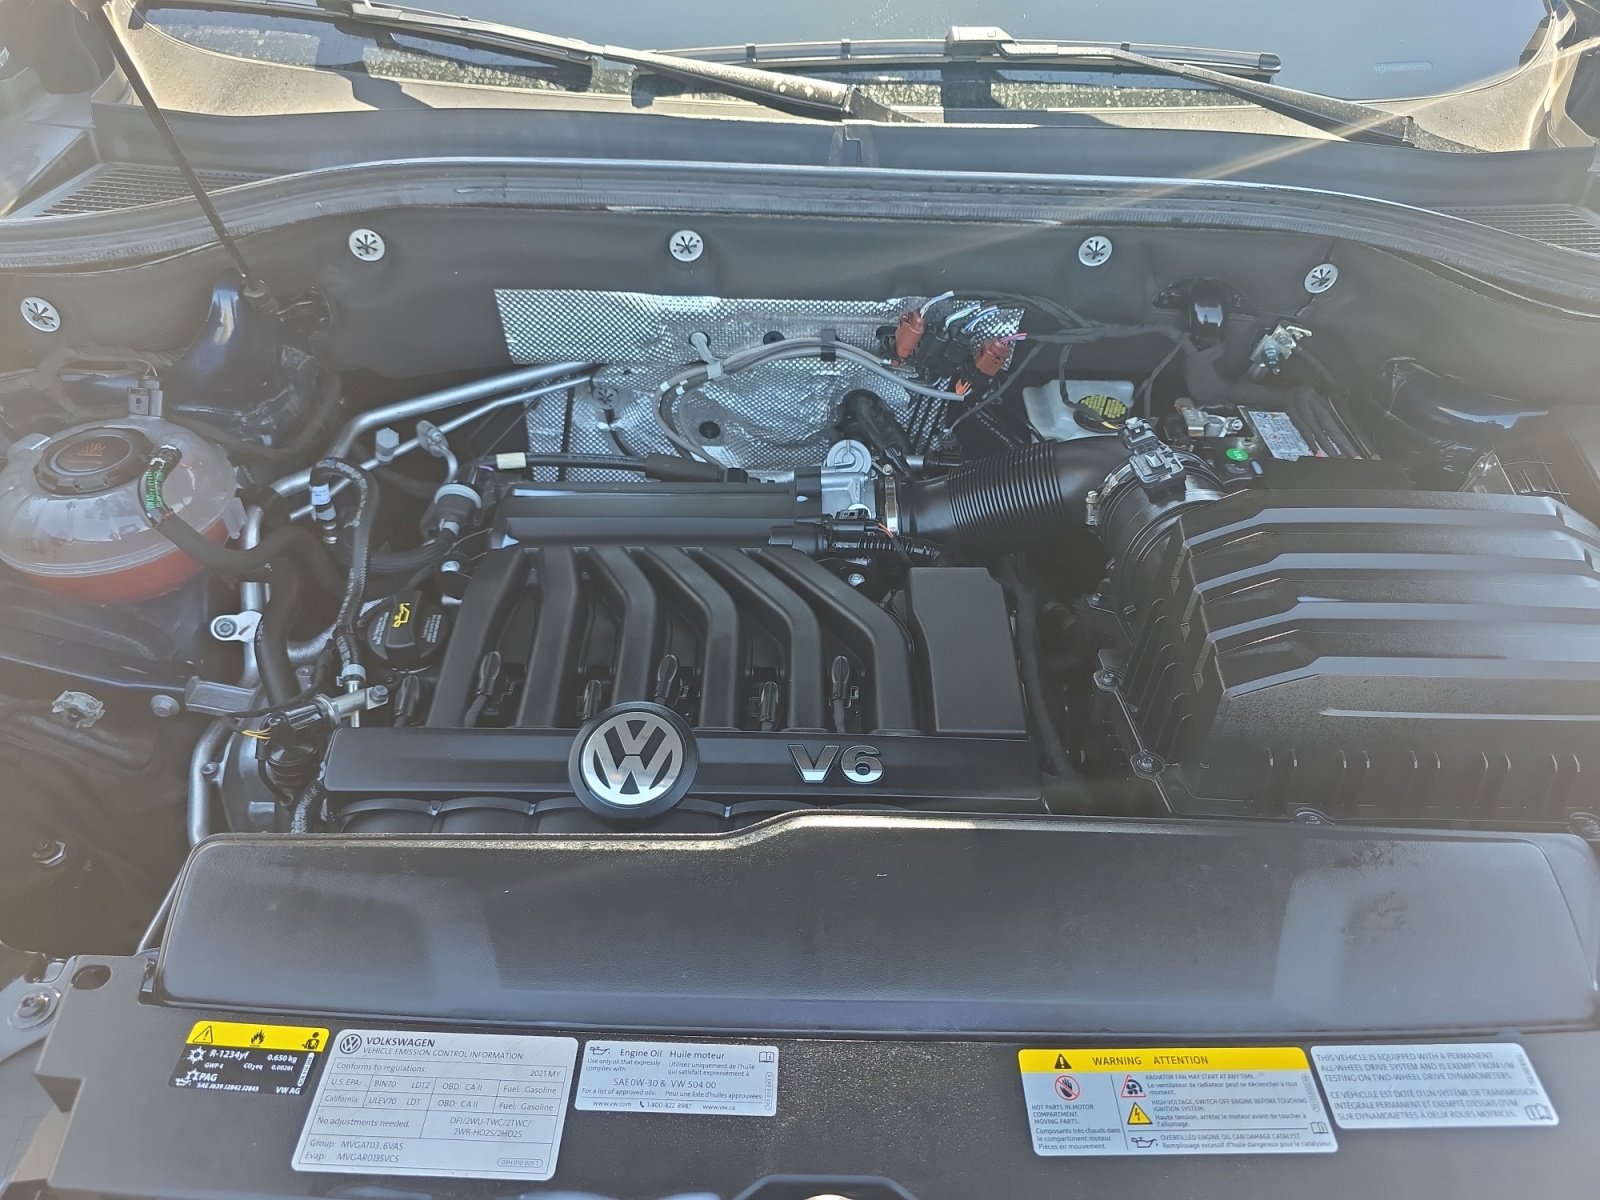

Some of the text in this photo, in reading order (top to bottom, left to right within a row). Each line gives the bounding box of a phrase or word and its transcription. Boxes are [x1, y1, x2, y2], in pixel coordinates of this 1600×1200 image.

[789, 744, 884, 784] V6
[366, 1037, 435, 1047] VOLKSWAGEN
[210, 1049, 298, 1064] R-1234yf 0.650 kg
[433, 1049, 467, 1058] CONTROL
[469, 1052, 524, 1060] INFORMATION
[620, 1049, 648, 1058] Engine
[1377, 1053, 1416, 1061] EQUIPPED
[1092, 1055, 1209, 1066] WARNING ATTENTION
[337, 1062, 372, 1070] Conforms
[199, 1072, 218, 1082] PAG
[275, 1086, 290, 1094] VW
[524, 1086, 556, 1094] Gasoline
[500, 1102, 554, 1112] Fuel: Gasoline
[330, 1118, 378, 1127] adjustments
[310, 1139, 336, 1148] Group:
